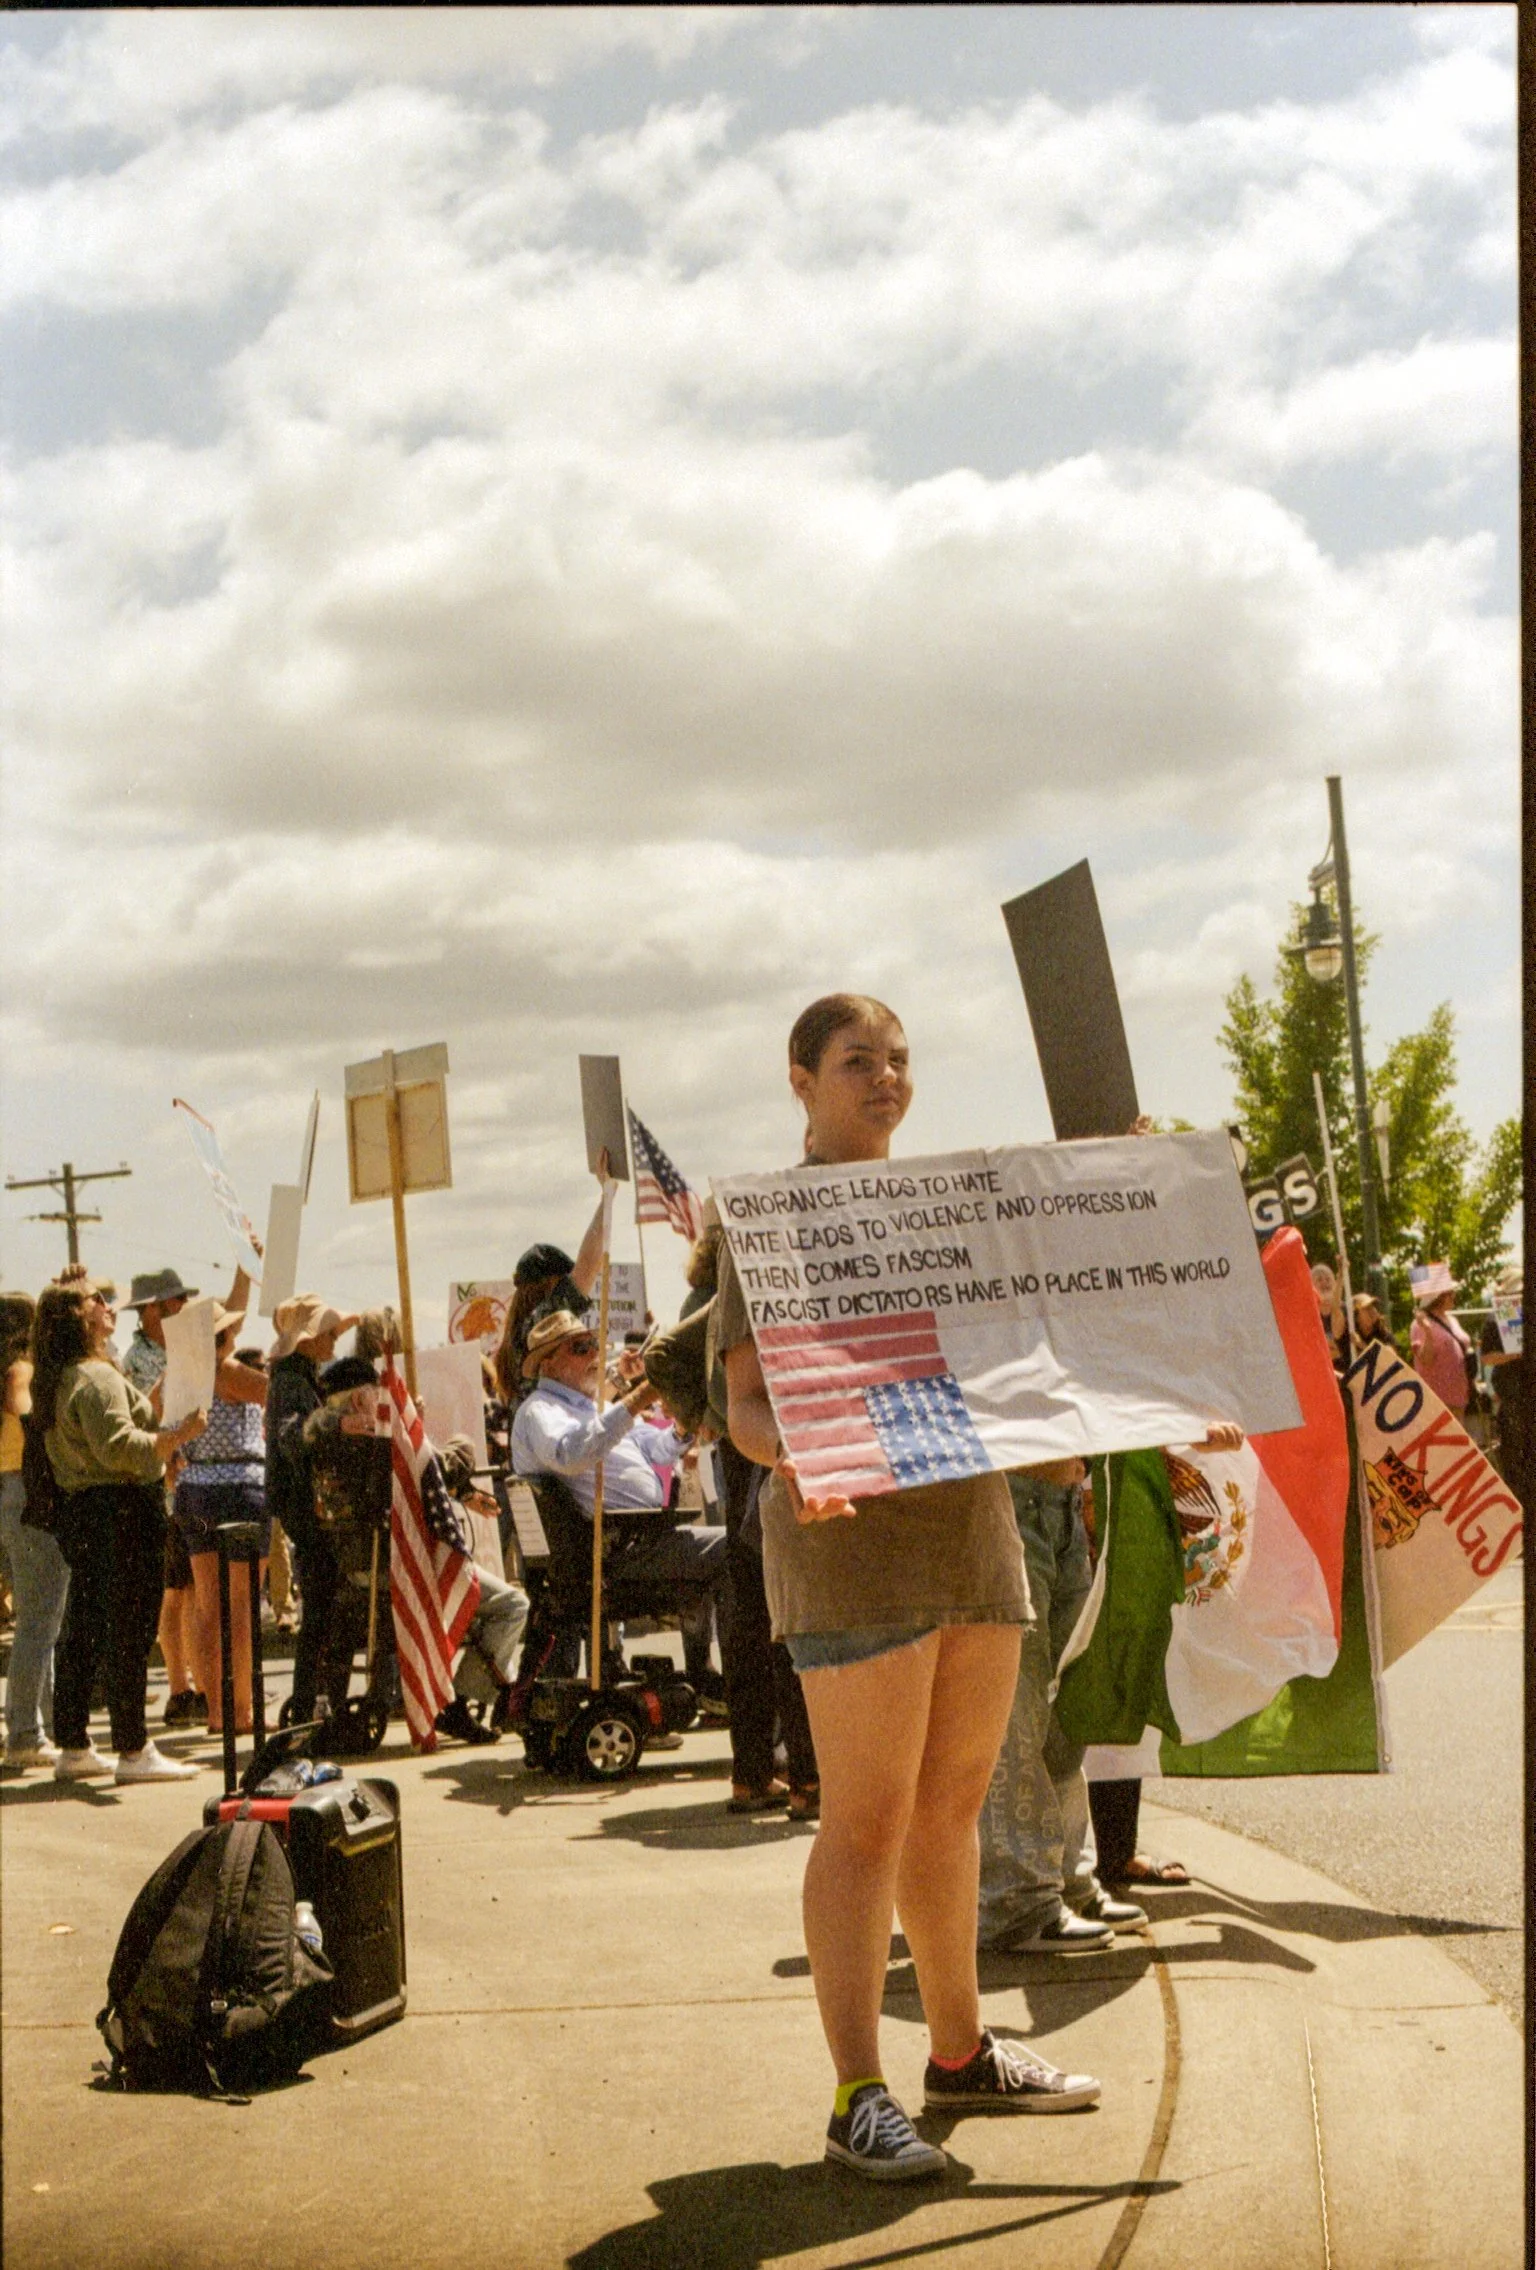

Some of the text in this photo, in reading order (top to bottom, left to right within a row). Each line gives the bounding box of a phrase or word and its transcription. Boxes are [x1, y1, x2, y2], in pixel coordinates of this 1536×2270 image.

[723, 1170, 1002, 1218] IGNORANCE LEADS TO HATE
[727, 1189, 1157, 1255] HATE LEADS TO VIOLENCE AND OPPRESSION
[741, 1246, 973, 1290] THEN COMES FASCISM
[751, 1257, 1230, 1323] FASCIST DICTATORS HAVE NO PLACE IN THIS WORLD
[1340, 1343, 1524, 1577] NO KINGS
